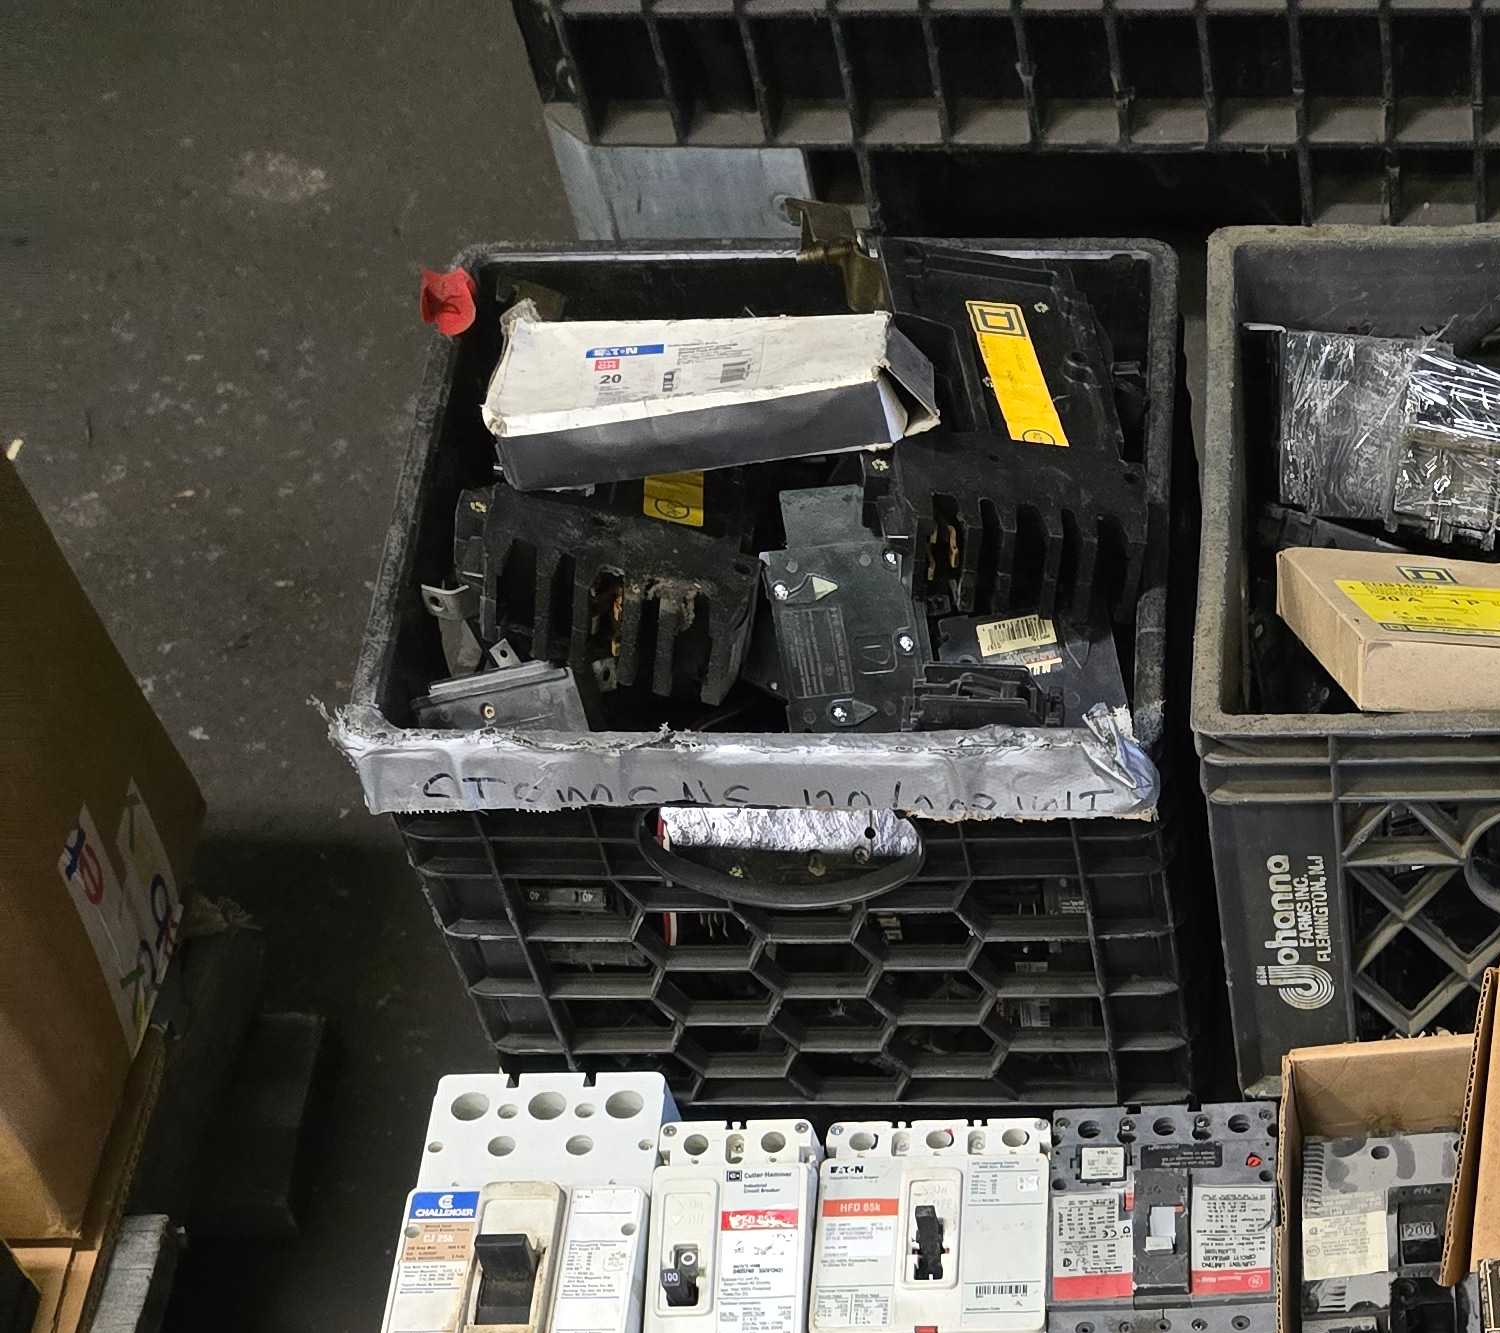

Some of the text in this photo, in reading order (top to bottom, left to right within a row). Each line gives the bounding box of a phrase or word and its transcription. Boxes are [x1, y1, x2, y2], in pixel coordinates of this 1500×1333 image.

[1295, 901, 1315, 948] FARMS
[415, 1208, 473, 1217] CHALLENGER
[839, 1203, 861, 1213] HFD
[663, 1271, 679, 1282] 100
